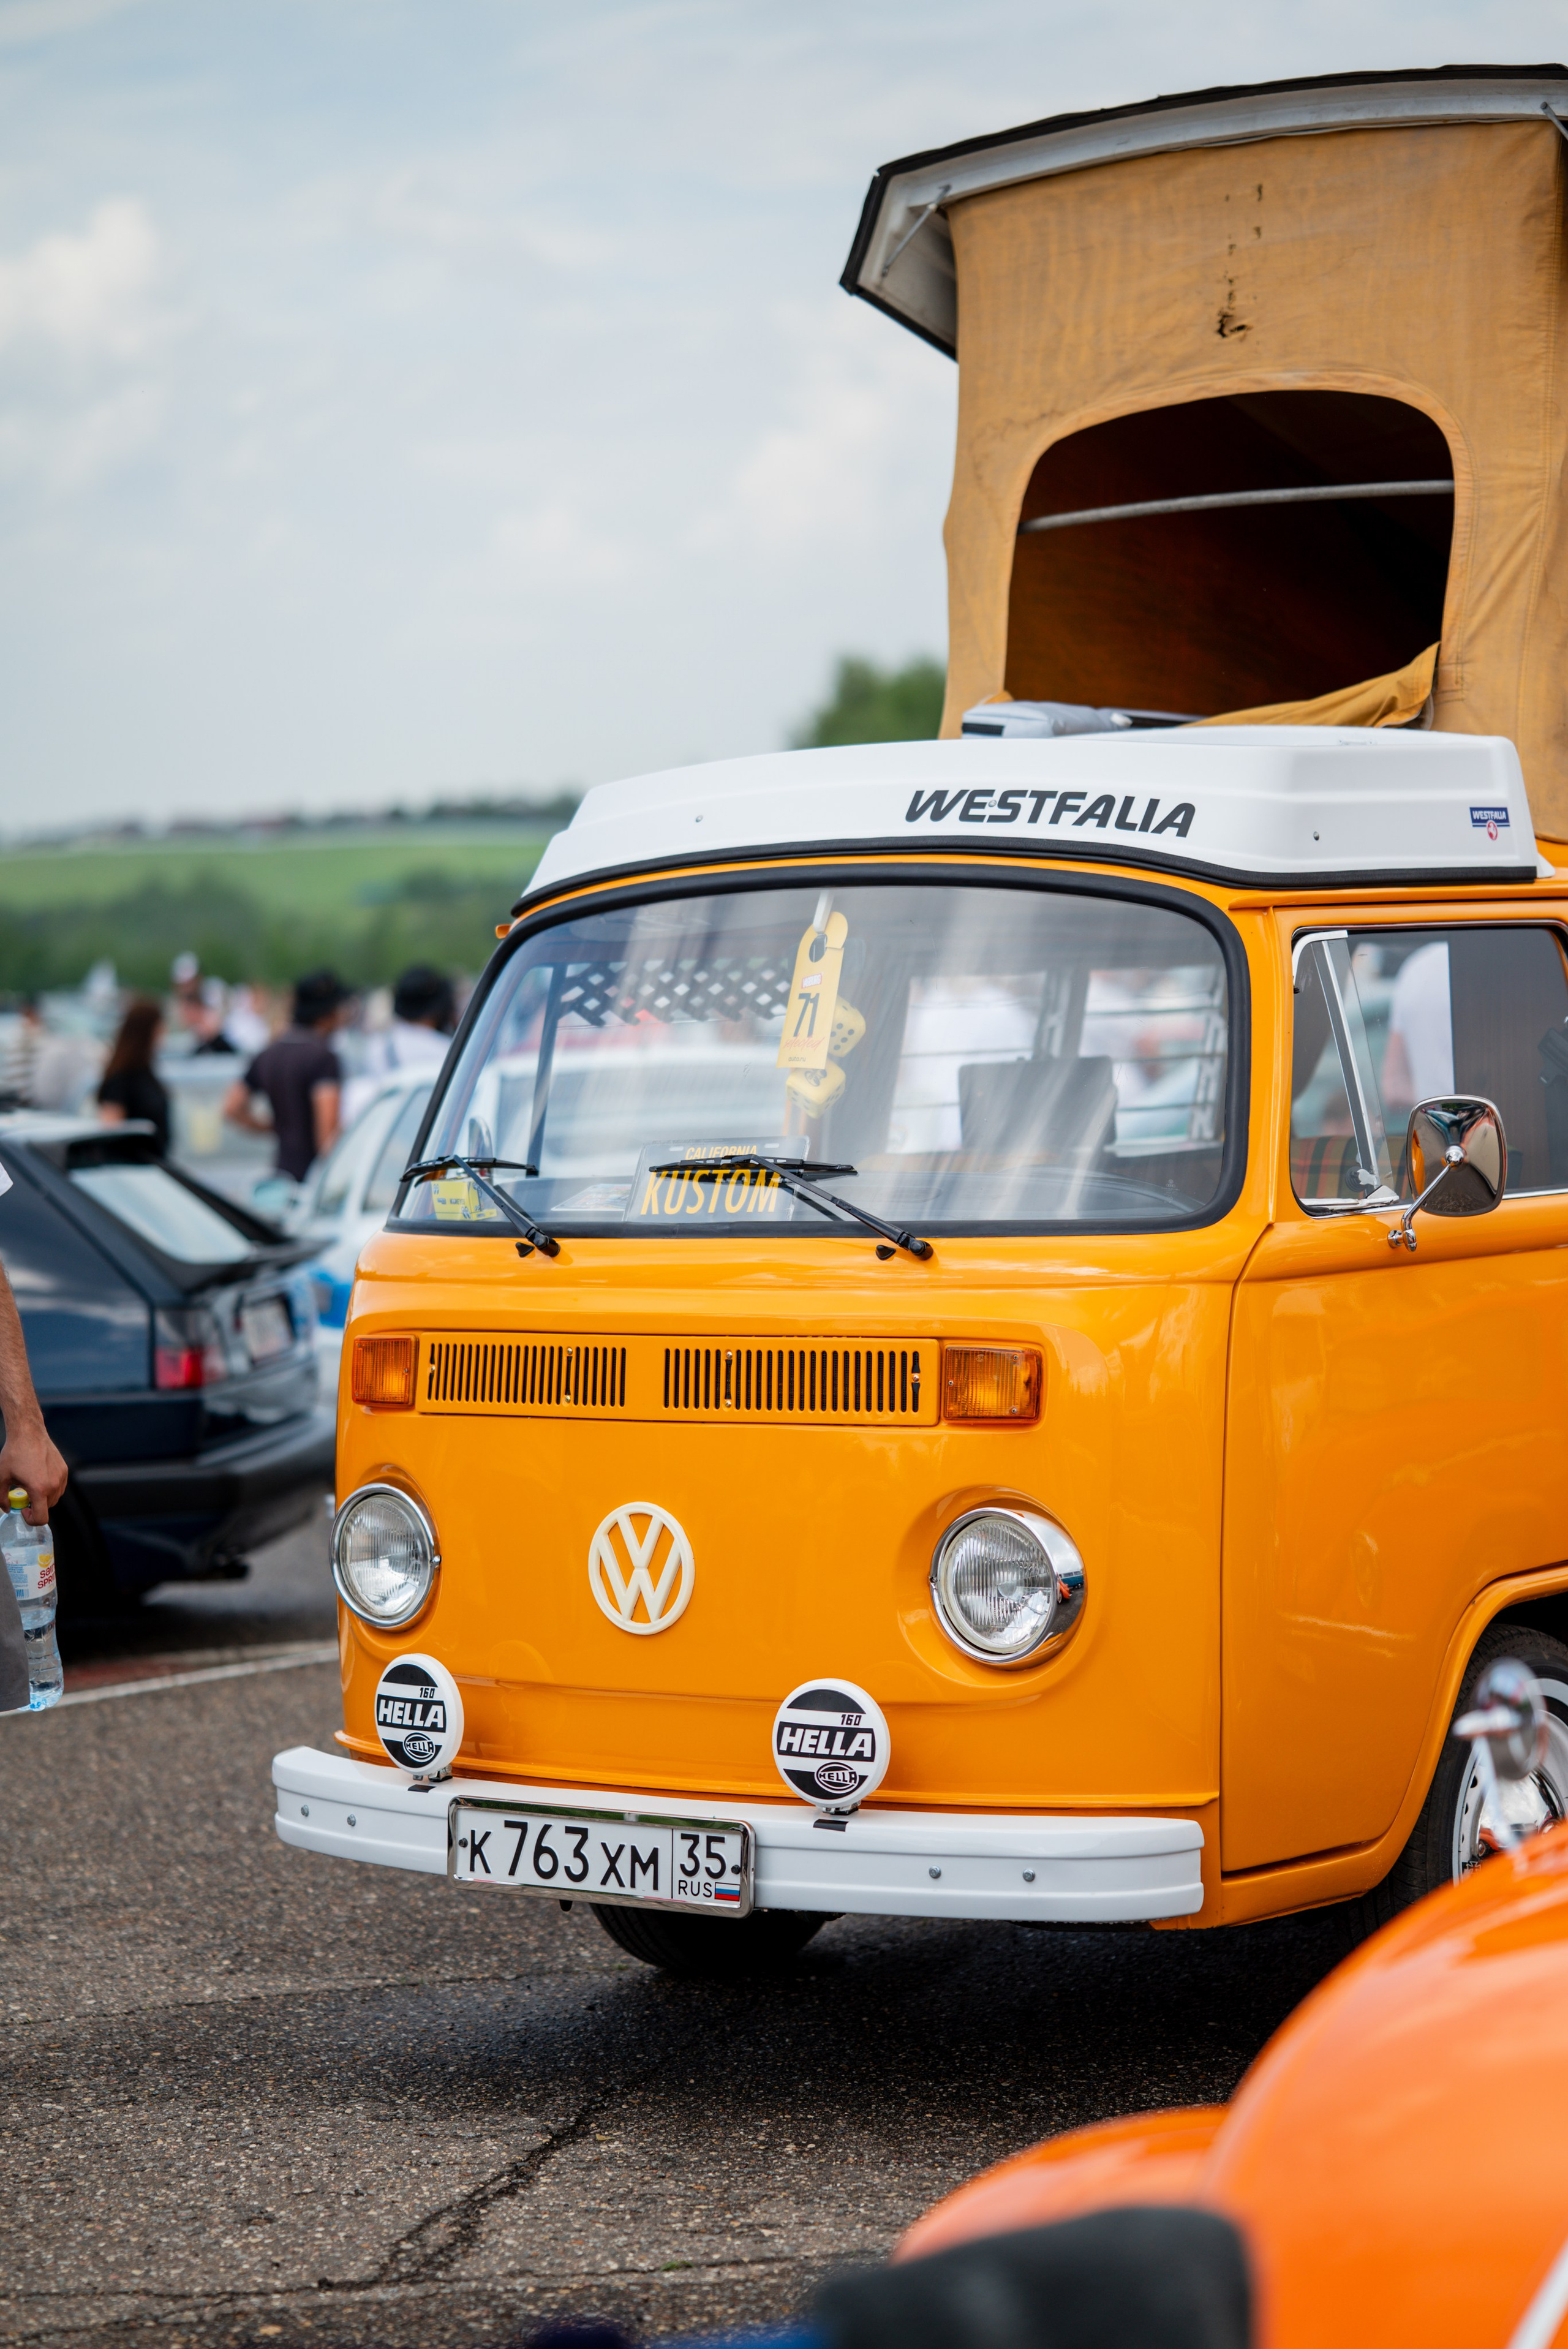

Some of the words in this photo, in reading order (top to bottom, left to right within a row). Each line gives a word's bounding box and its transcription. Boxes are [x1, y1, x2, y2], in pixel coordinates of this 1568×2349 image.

[905, 789, 1196, 838] WESTFALIA
[1472, 810, 1507, 820] WESTFALIA
[793, 992, 820, 1038] 71
[685, 1145, 758, 1160] CALIFORNIA
[640, 1169, 780, 1215] KUSTOM
[419, 1687, 435, 1699] 160
[378, 1699, 444, 1729] HELLA
[840, 1714, 862, 1726] 160
[406, 1740, 434, 1754] HELLA
[778, 1726, 872, 1757] HELLA
[818, 1770, 858, 1785] HELLA
[679, 1833, 726, 1879] 35
[677, 1879, 712, 1898] RUS
